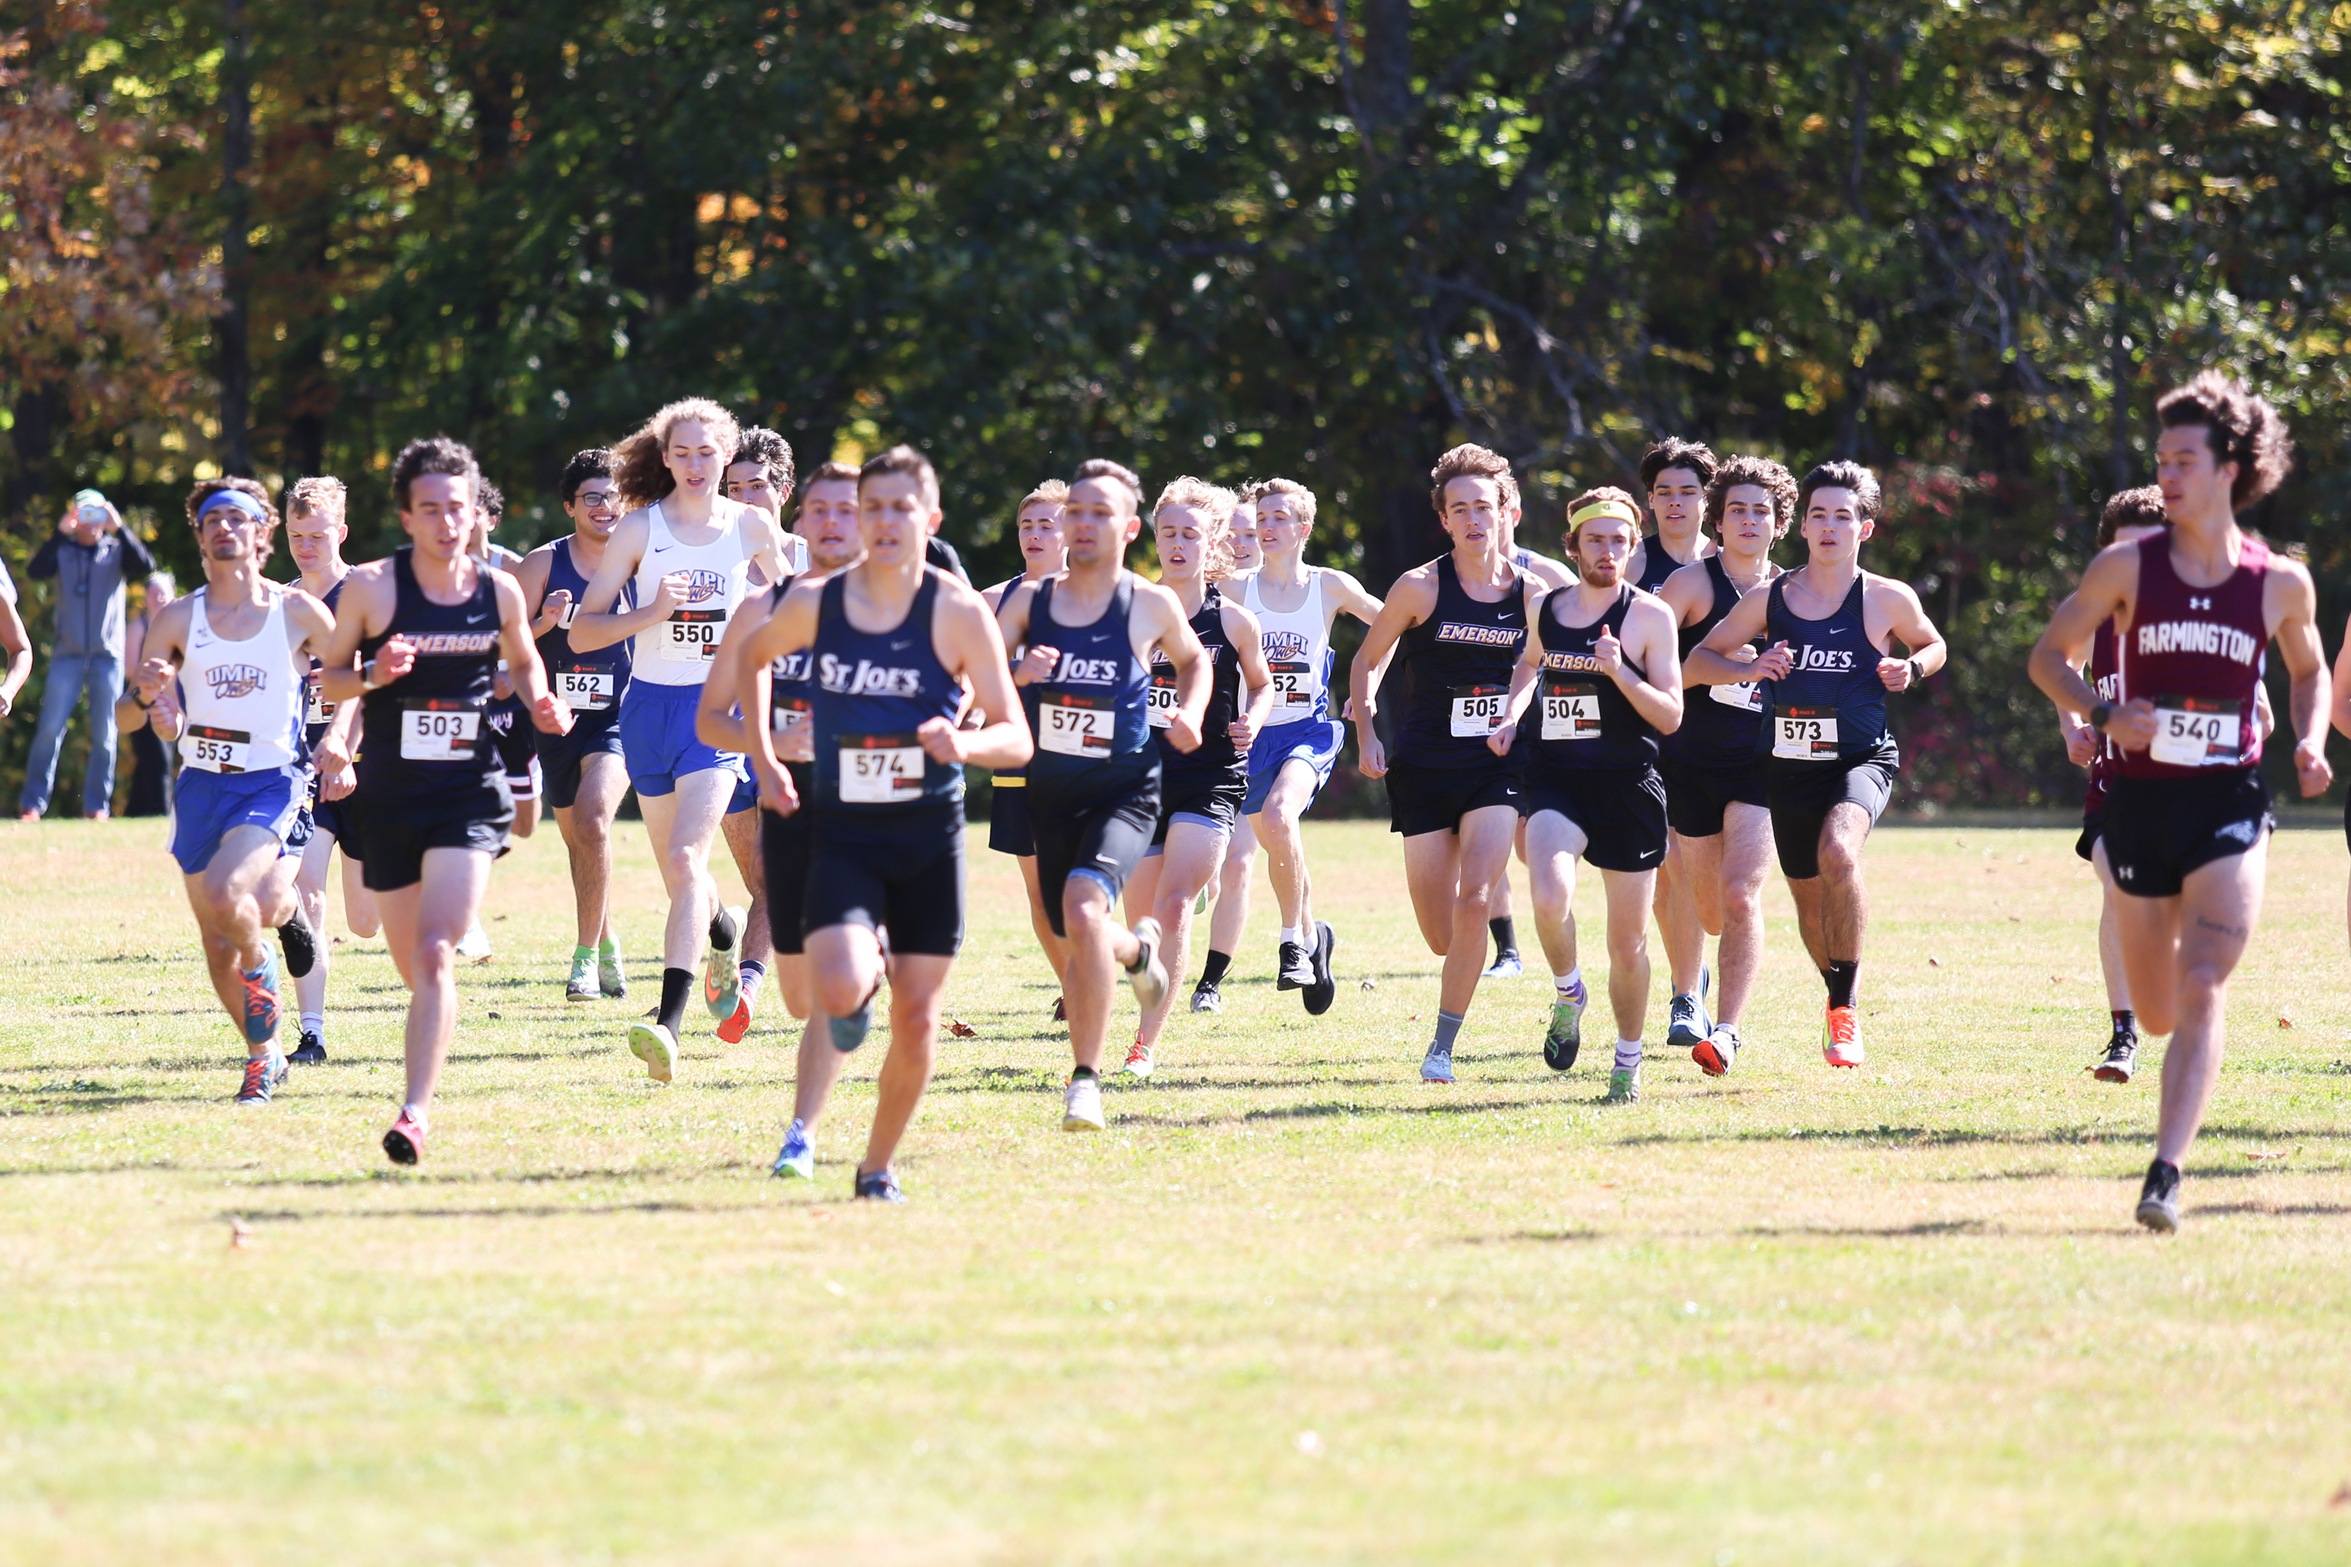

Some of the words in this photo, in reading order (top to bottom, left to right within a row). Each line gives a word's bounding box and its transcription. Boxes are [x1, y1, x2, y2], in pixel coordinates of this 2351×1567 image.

[668, 569, 725, 596] MPI
[673, 624, 714, 643] 550
[1439, 624, 1519, 646] EMERSON
[2138, 621, 2257, 667] FARMINGTON
[1054, 652, 1118, 683] JOE'S
[1543, 652, 1603, 672] MERSO
[1796, 644, 1853, 670] JOE'S
[206, 664, 267, 690] UMPI
[566, 675, 600, 692] 562
[1273, 675, 1297, 692] 52
[1463, 697, 1499, 717] 505
[1548, 699, 1585, 719] 504
[417, 715, 463, 736] 503
[1053, 709, 1095, 733] 572
[1783, 720, 1822, 740] 573
[2169, 714, 2221, 741] 540
[196, 740, 233, 762] 553
[856, 753, 905, 777] 574
